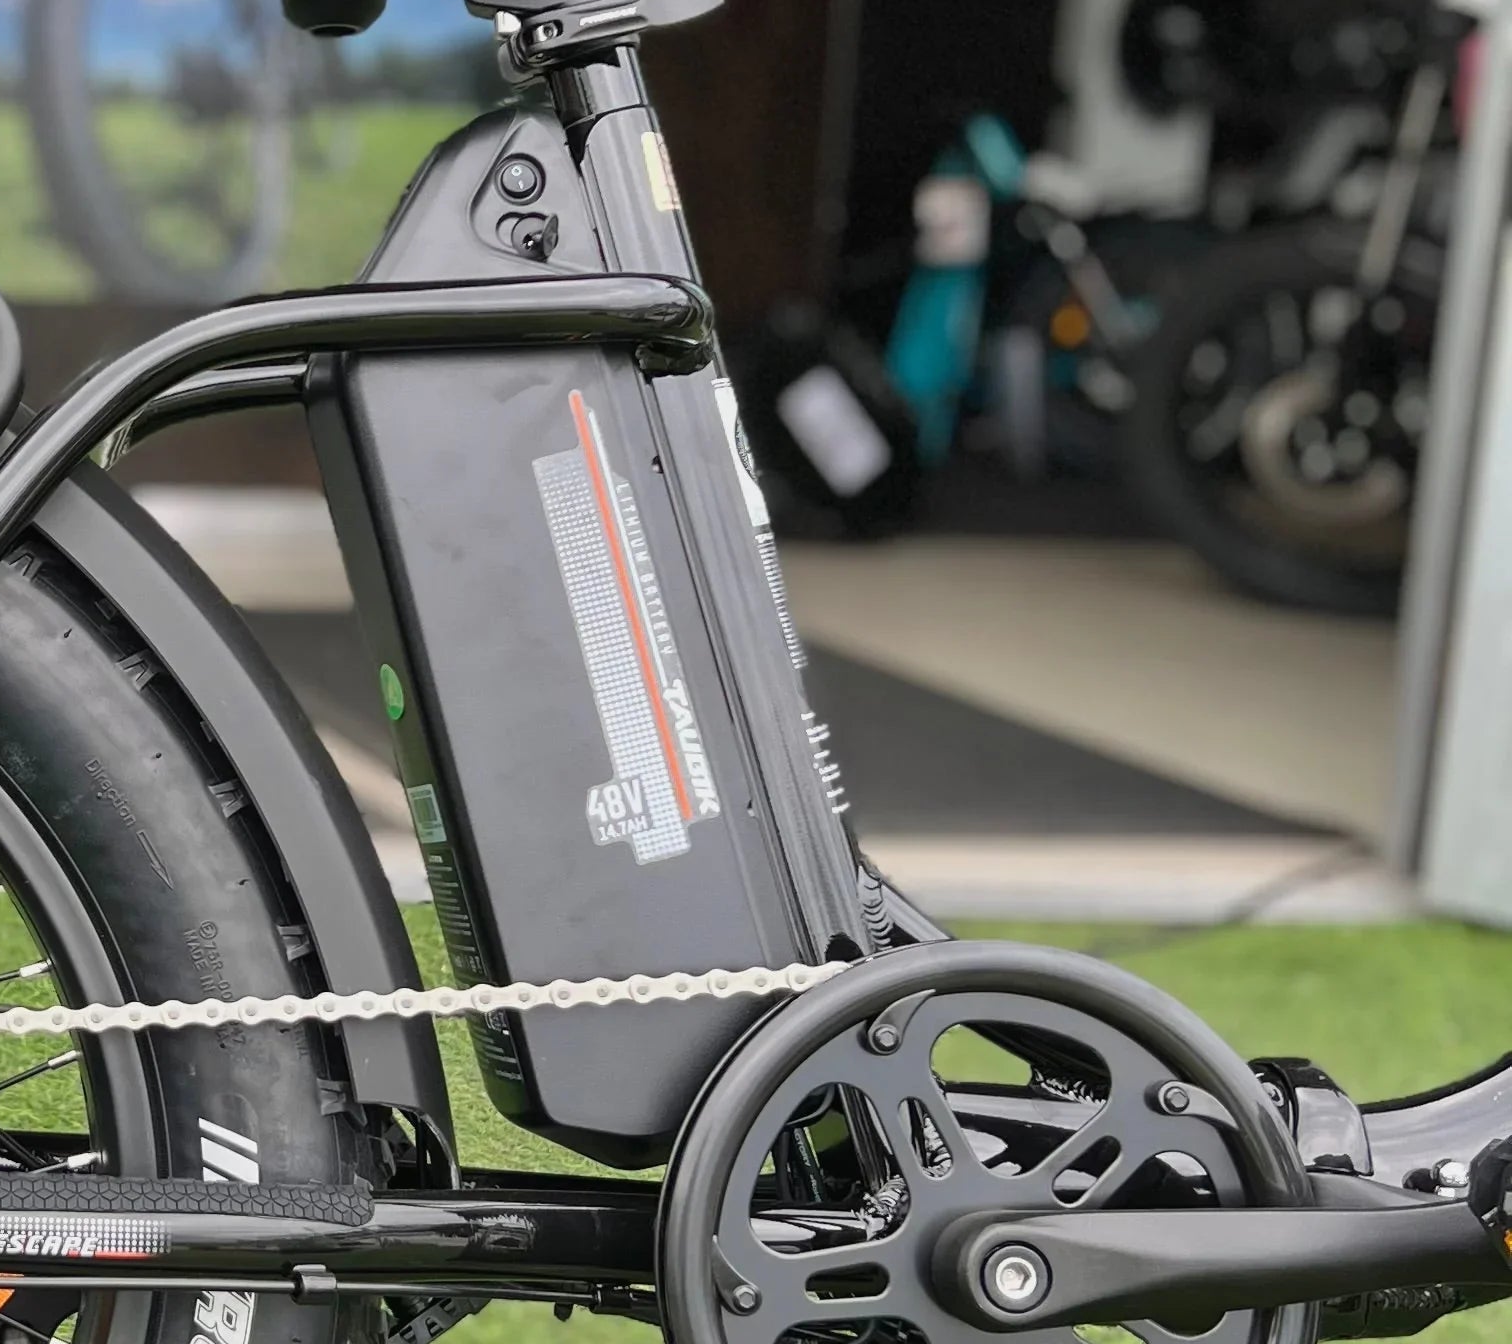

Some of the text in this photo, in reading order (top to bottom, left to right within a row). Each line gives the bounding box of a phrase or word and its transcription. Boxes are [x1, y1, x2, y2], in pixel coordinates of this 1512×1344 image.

[615, 481, 675, 655] LITHIUM BATTERY
[587, 777, 644, 823] 48V
[597, 814, 649, 842] 14.7AH
